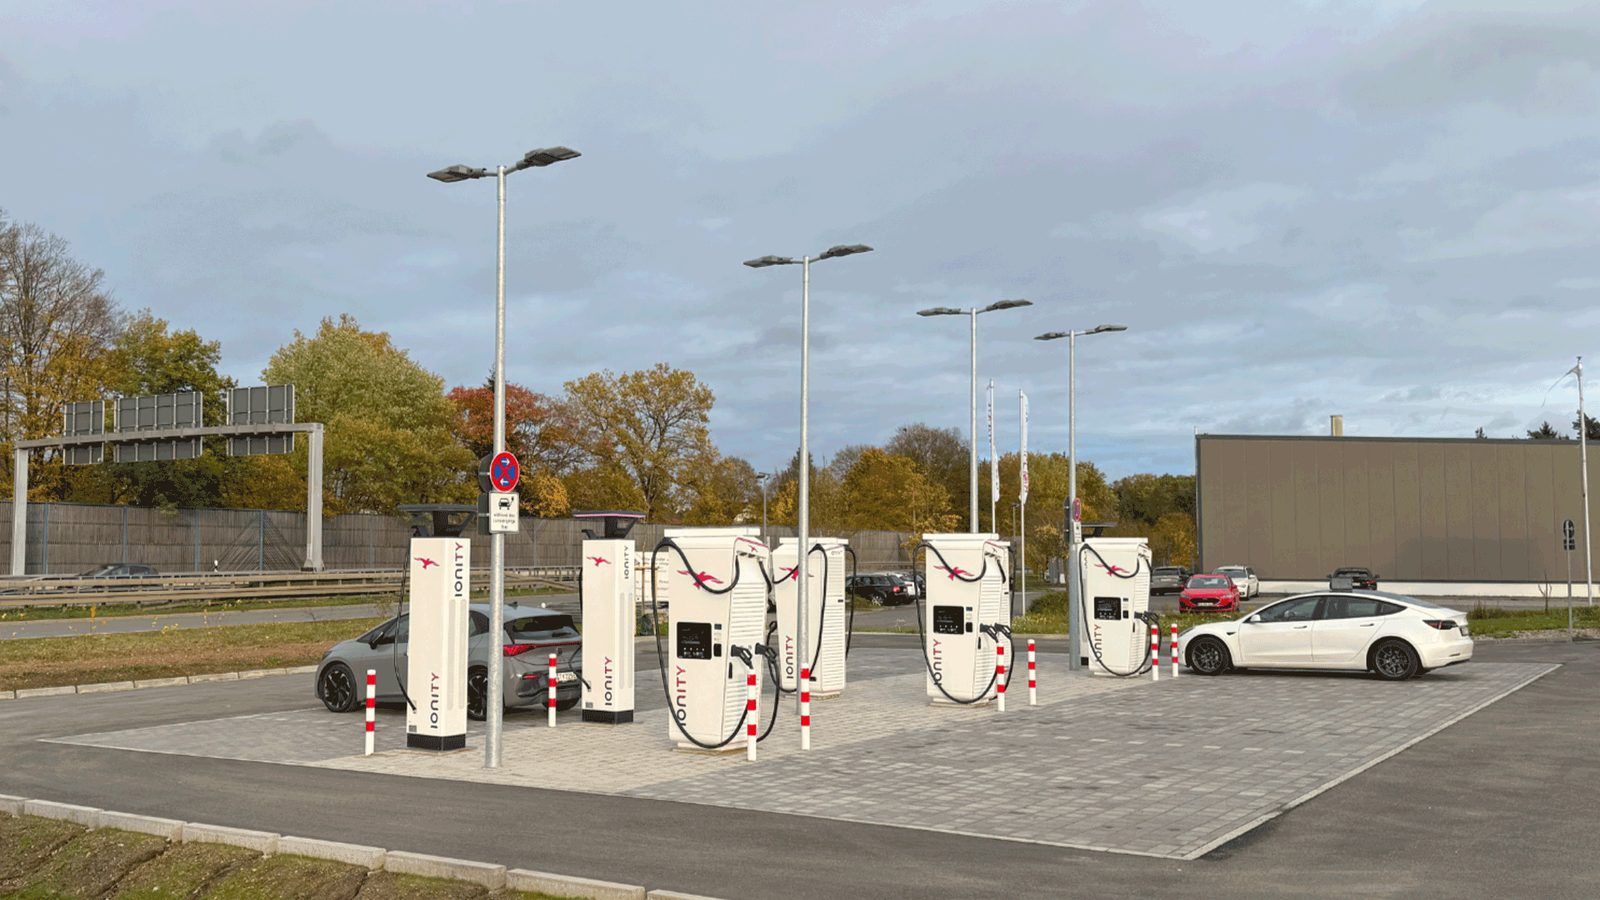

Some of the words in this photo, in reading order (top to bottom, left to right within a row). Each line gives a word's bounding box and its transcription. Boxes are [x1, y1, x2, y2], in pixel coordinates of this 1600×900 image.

[454, 542, 463, 597] IONITY
[785, 635, 794, 679] IONITY
[933, 639, 942, 686] IONITY
[430, 672, 439, 729] IONITY
